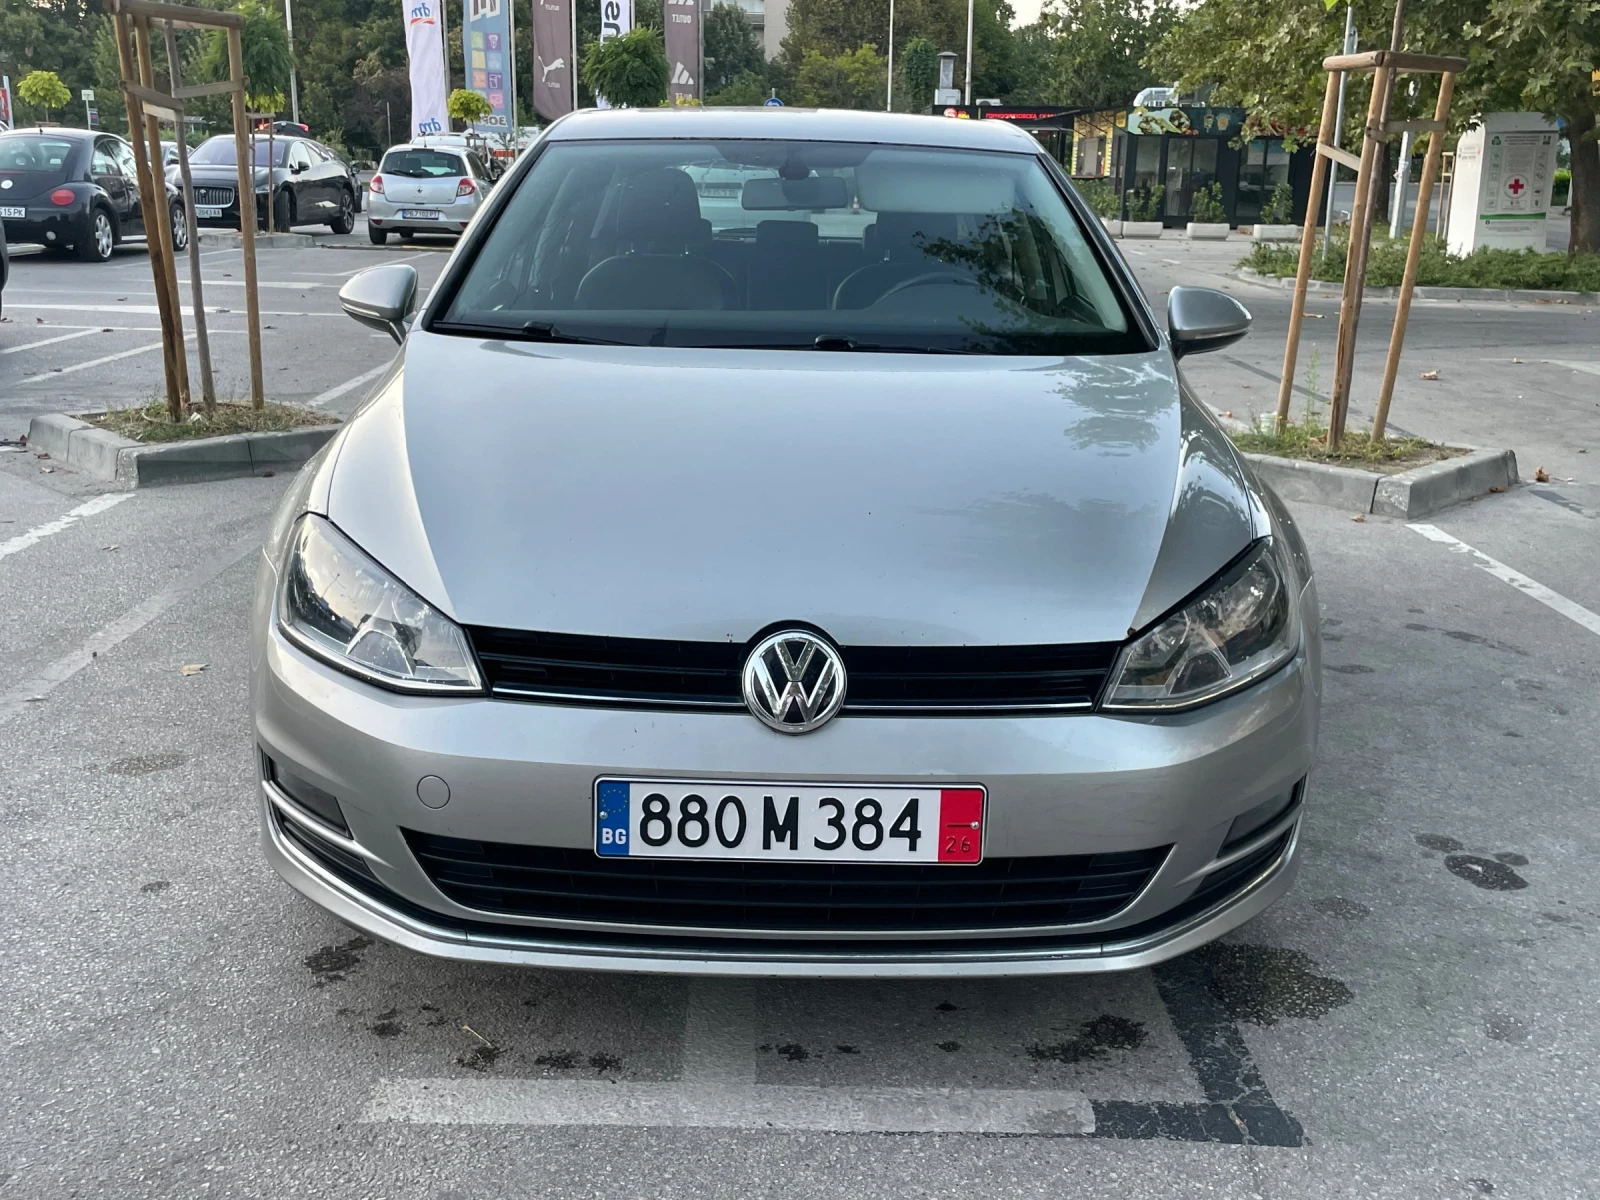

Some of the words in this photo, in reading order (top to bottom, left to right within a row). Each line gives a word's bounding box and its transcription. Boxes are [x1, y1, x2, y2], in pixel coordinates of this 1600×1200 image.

[640, 793, 747, 849] 880
[763, 796, 799, 850] M
[814, 797, 921, 852] 384
[602, 827, 627, 845] BG
[946, 835, 971, 853] 26
